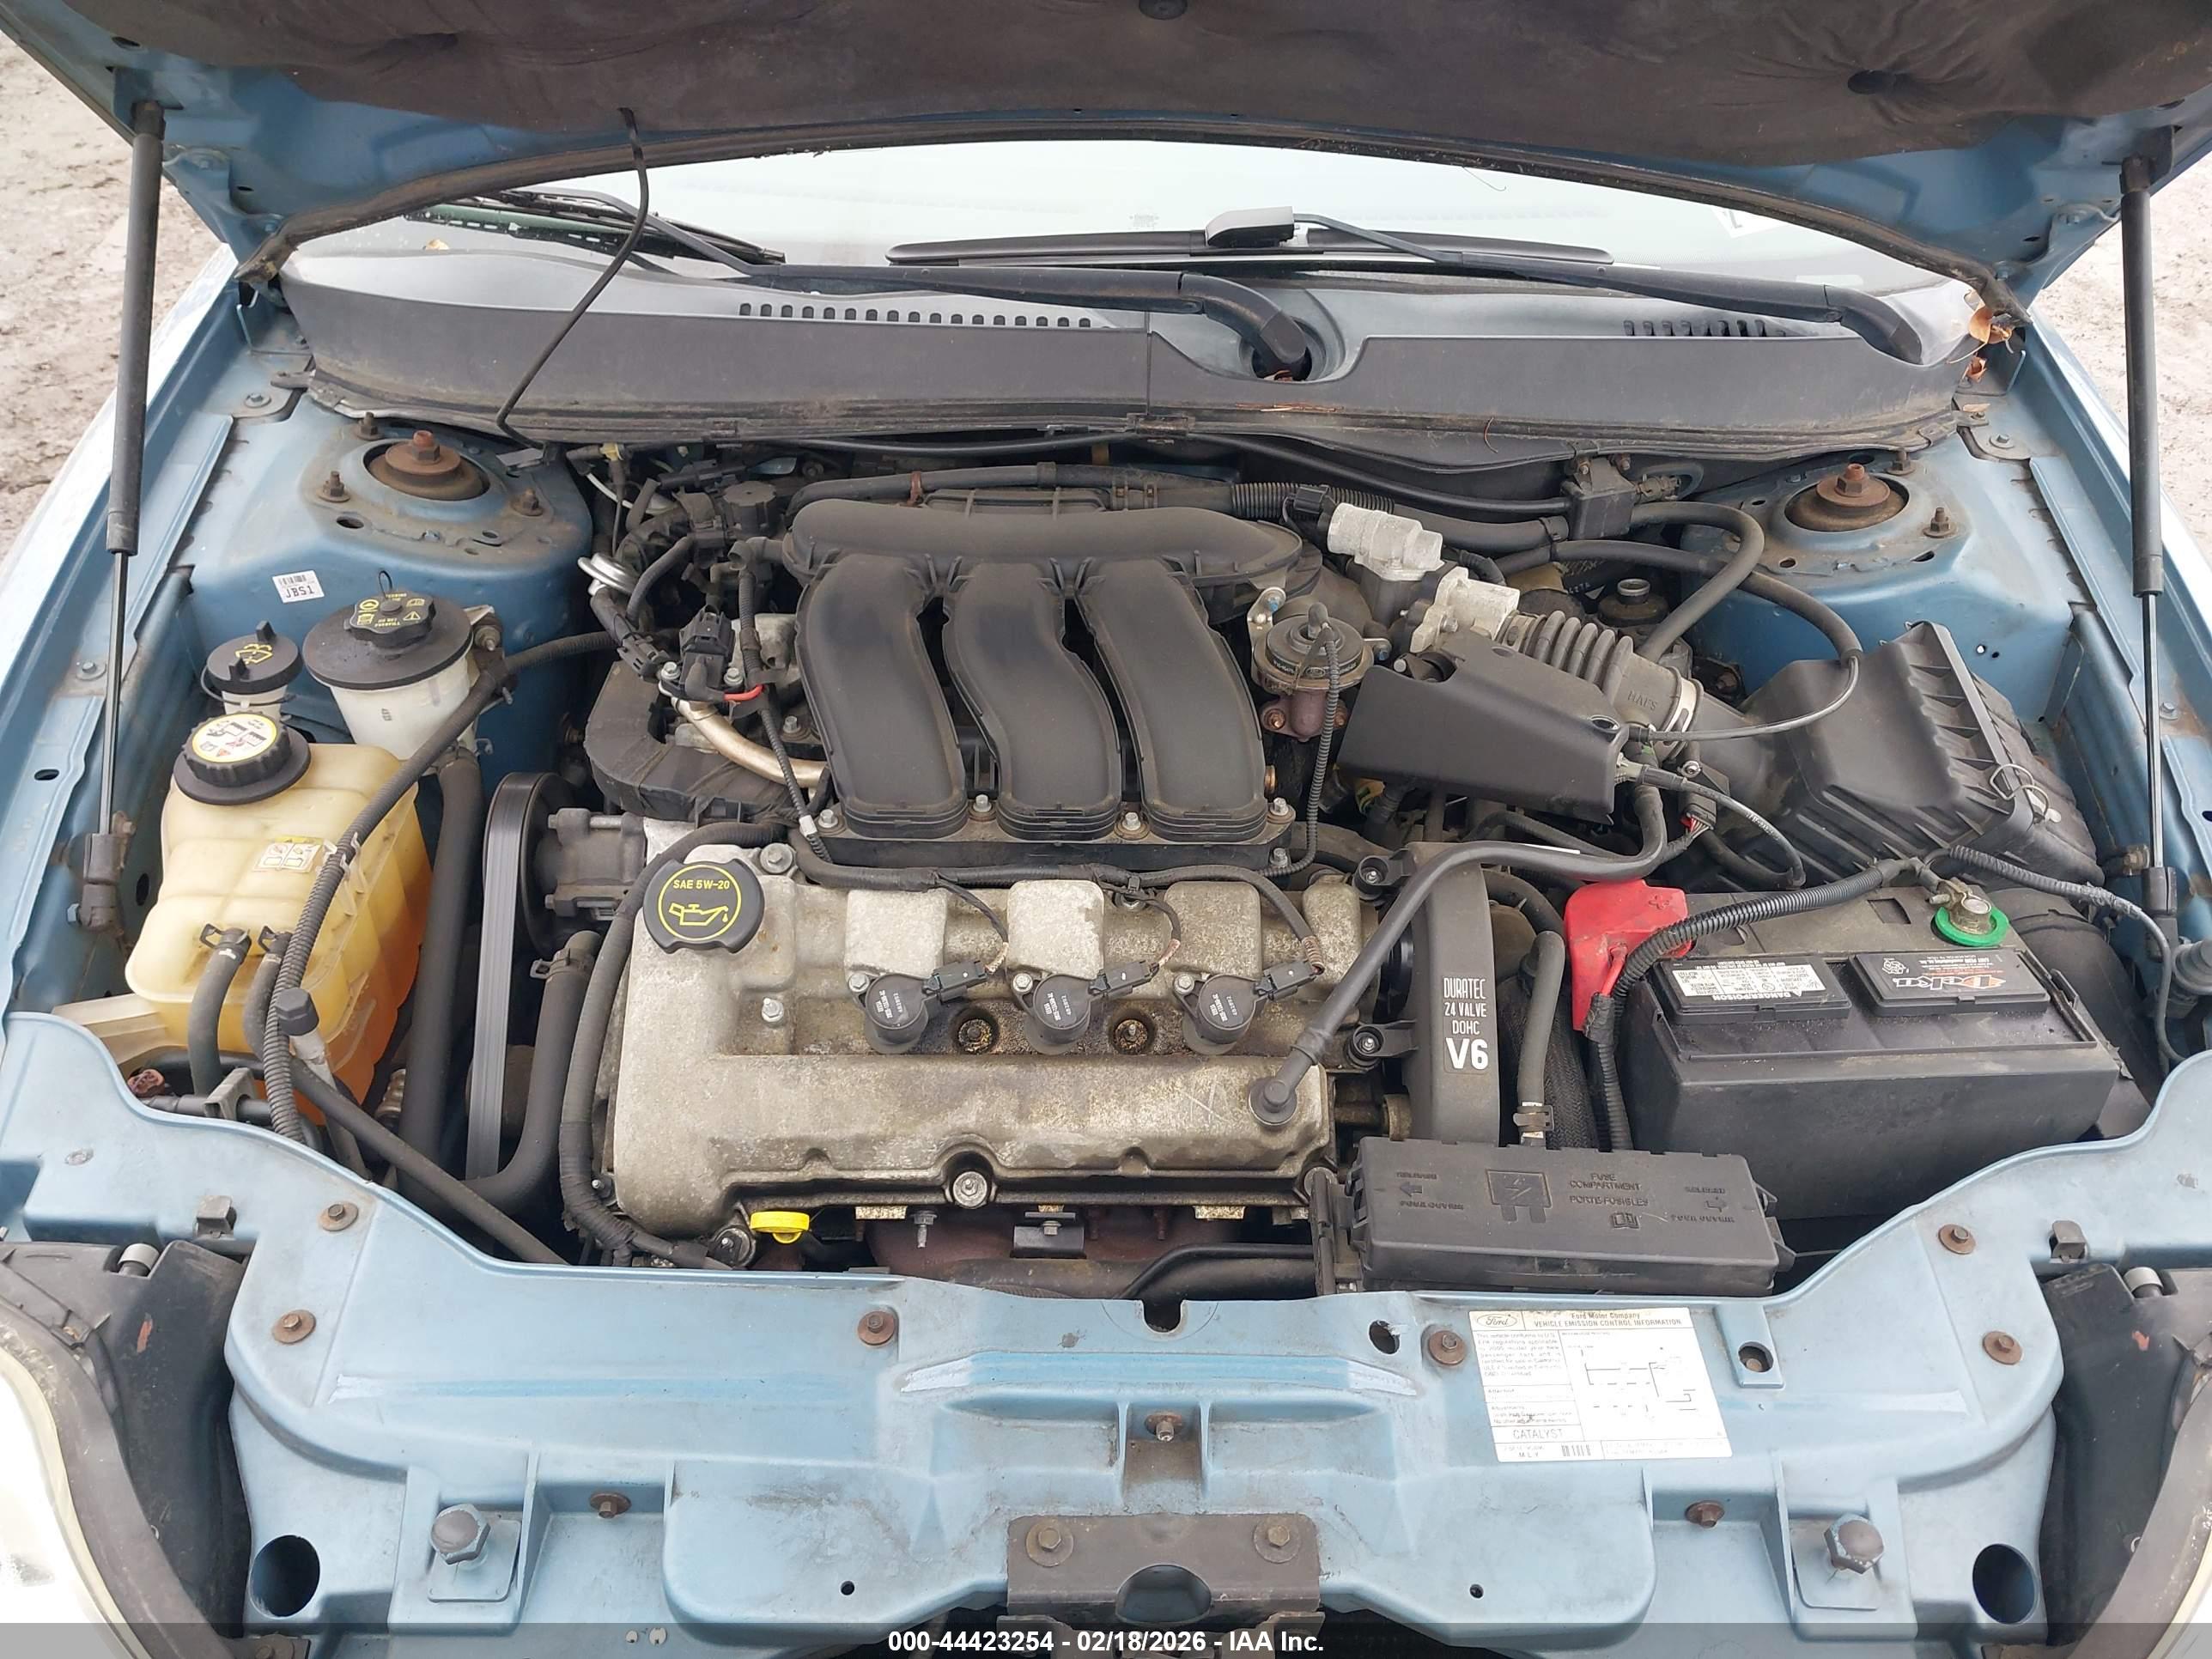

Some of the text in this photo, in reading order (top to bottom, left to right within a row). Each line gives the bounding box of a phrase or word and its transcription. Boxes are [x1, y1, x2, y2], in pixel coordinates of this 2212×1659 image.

[286, 585, 315, 599] JBS1
[673, 879, 731, 890] SAE 5W-20
[1443, 977, 1486, 1000] DURATEC
[1444, 1002, 1487, 1018] 24 VALVE
[1452, 1019, 1480, 1035] DOHC
[1445, 1037, 1489, 1070] V6
[1486, 1316, 1509, 1326] Ford
[1610, 1311, 1640, 1320] Company
[1513, 1428, 1563, 1439] CATALYST
